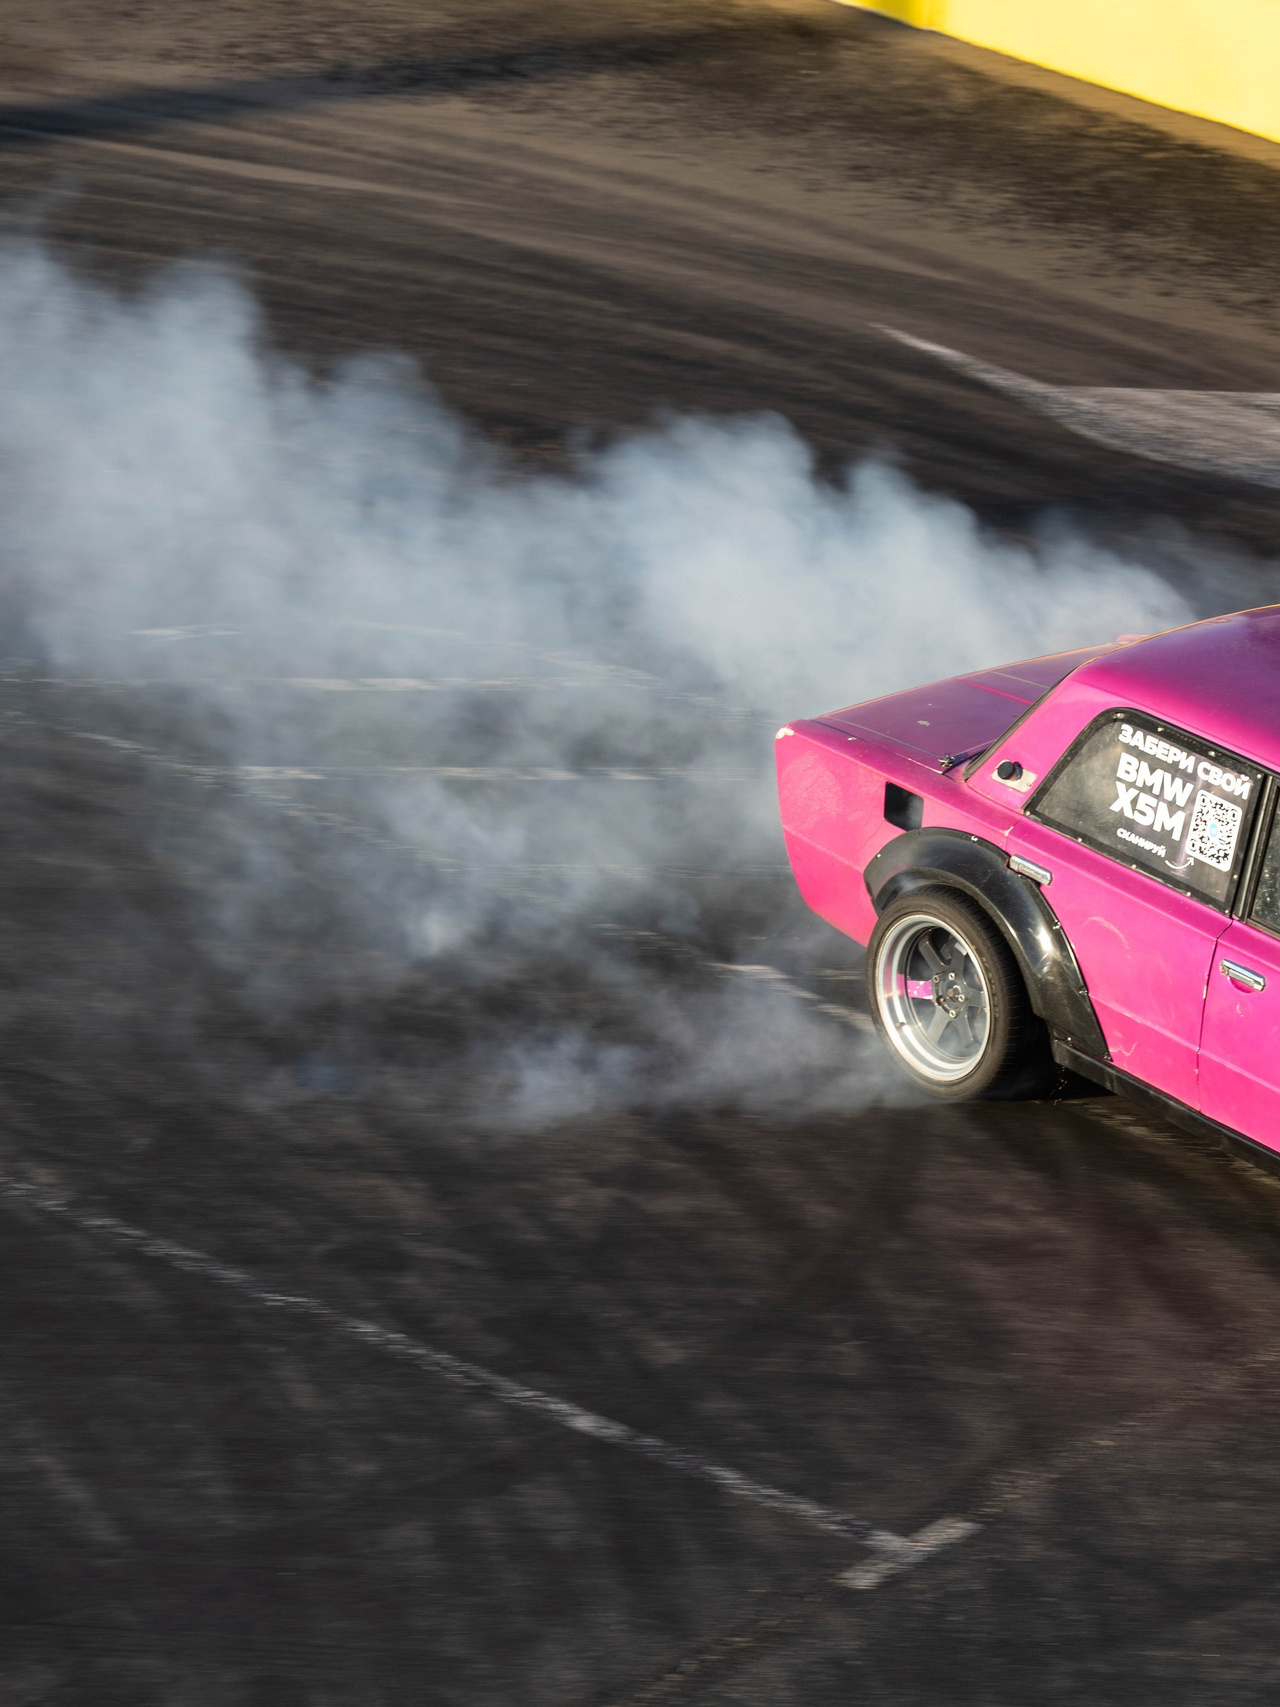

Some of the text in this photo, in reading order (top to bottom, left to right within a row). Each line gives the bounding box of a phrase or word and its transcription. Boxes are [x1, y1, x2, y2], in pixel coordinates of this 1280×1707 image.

[1116, 752, 1194, 807] BMW
[1118, 724, 1250, 800] ЗАБЕРИ СВОЙ
[1109, 781, 1186, 841] X5M
[1116, 827, 1166, 858] СКАНИРУЙ
